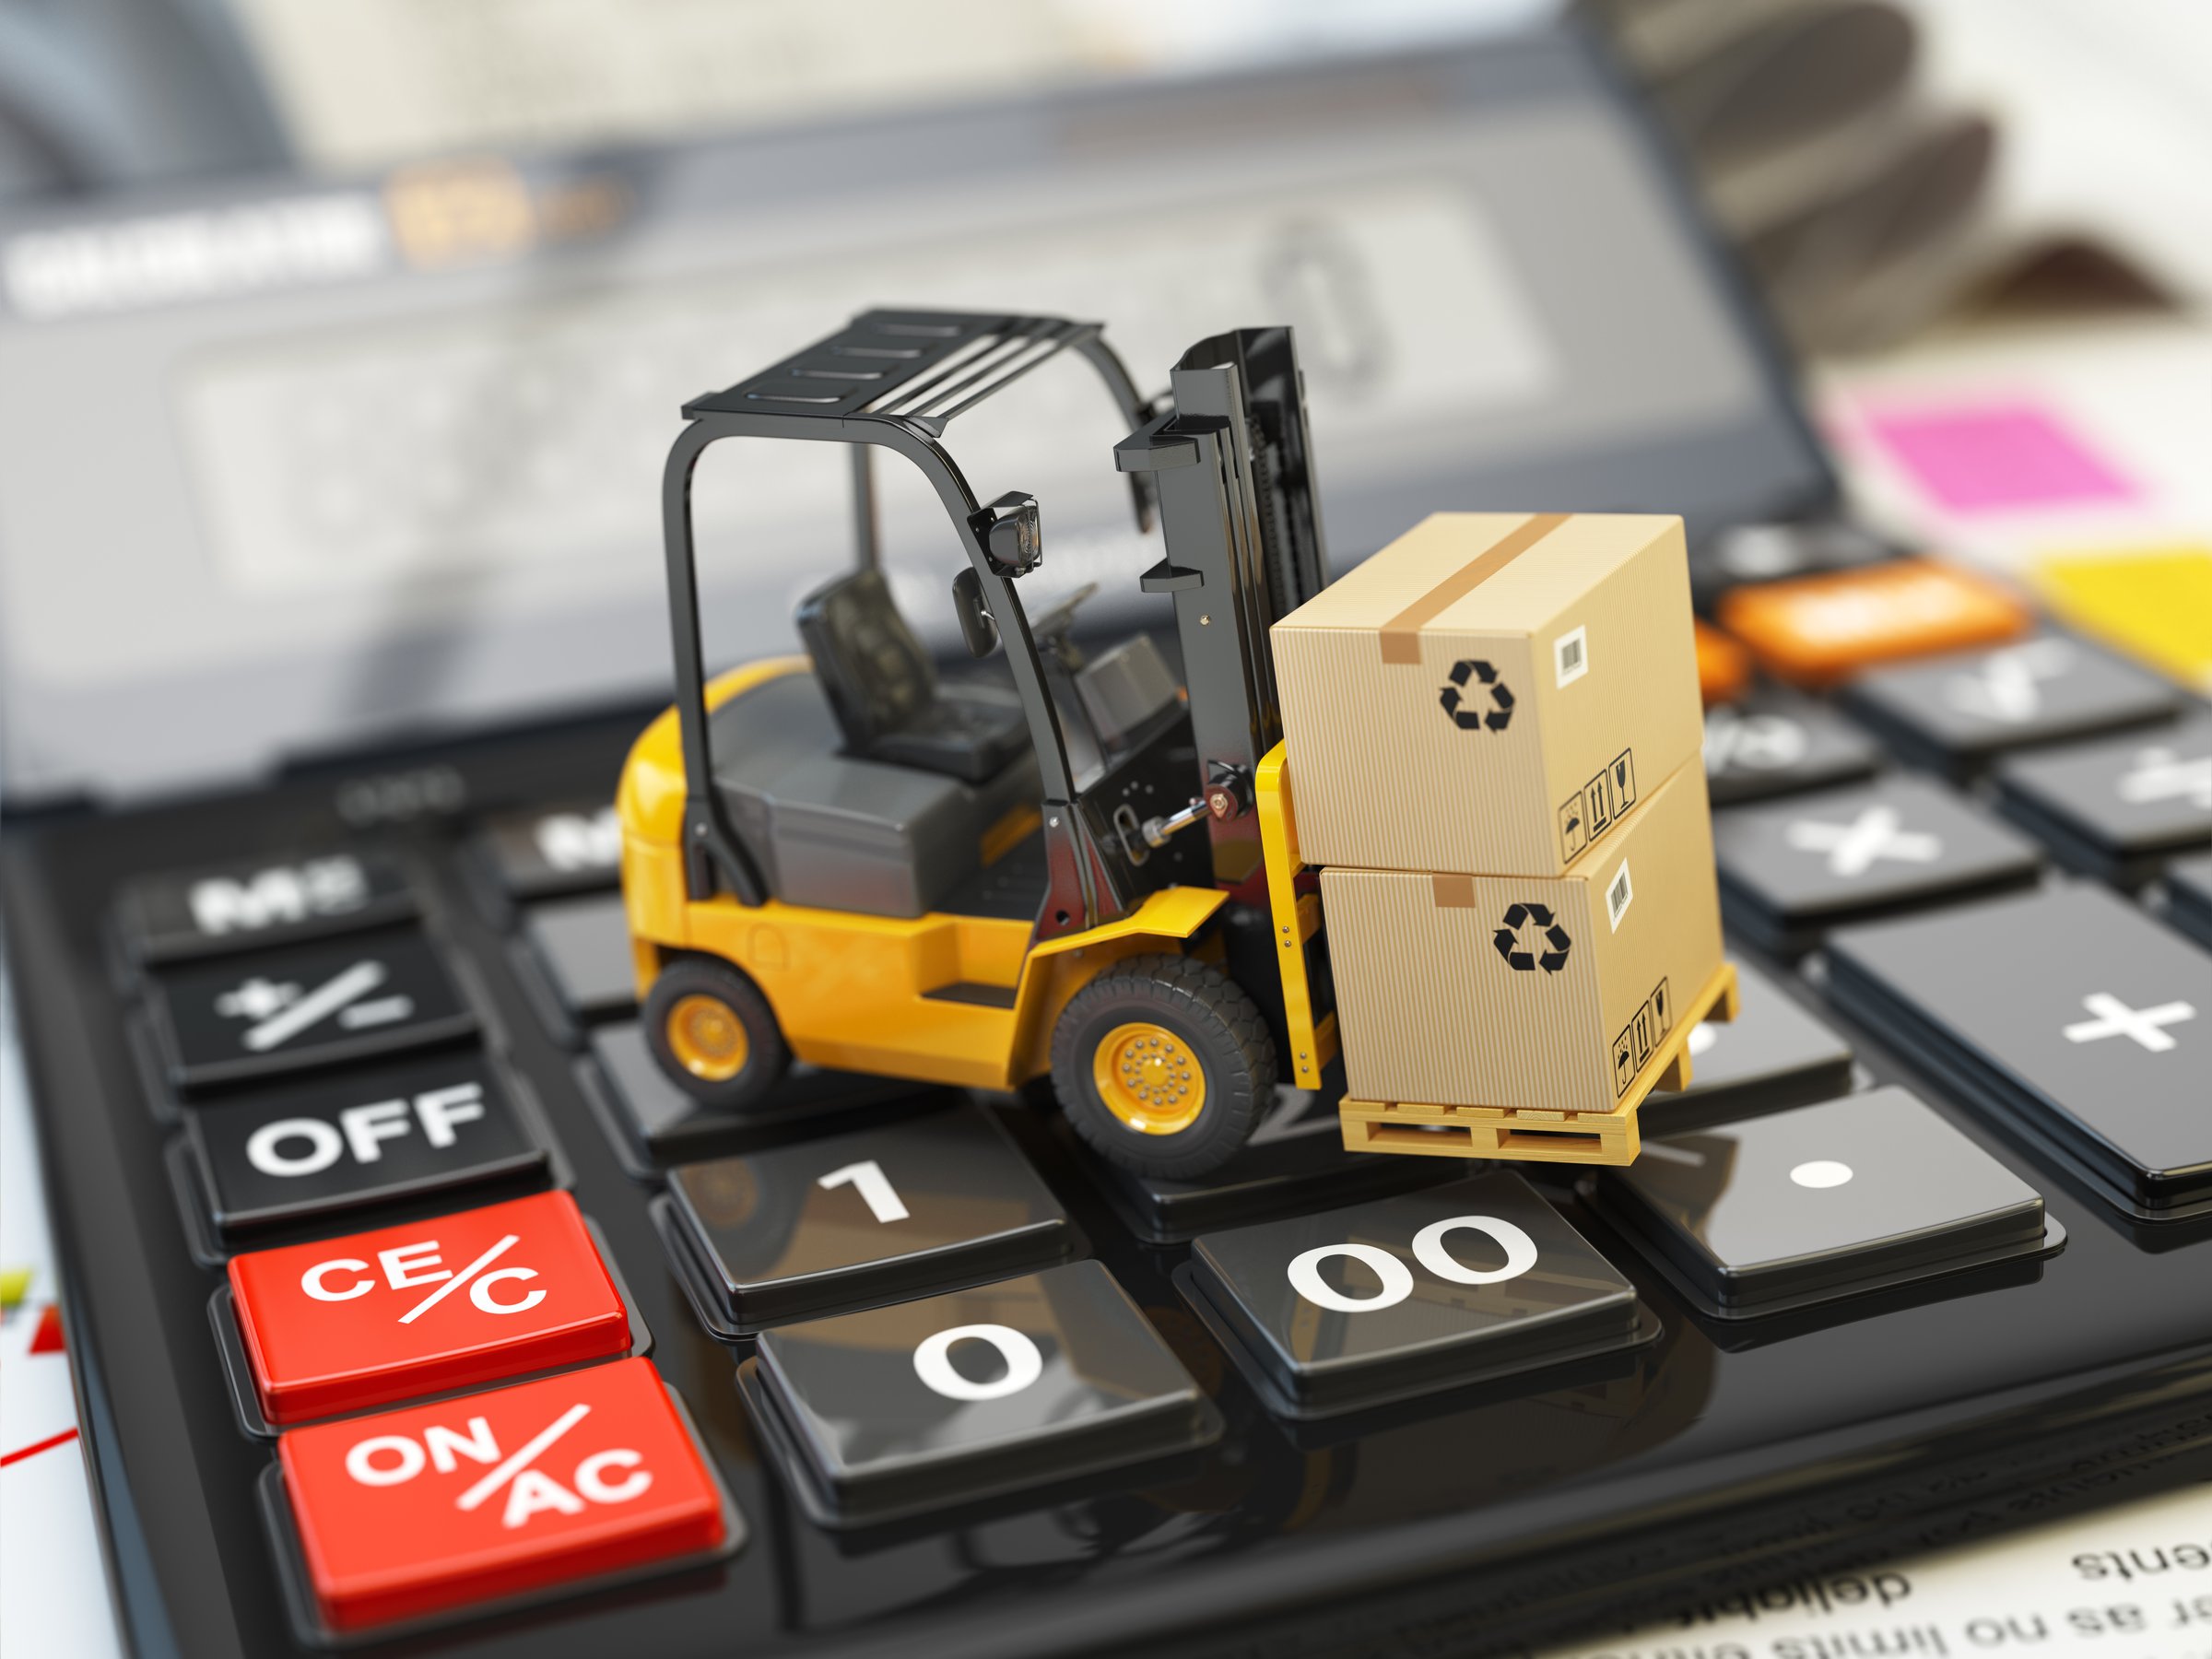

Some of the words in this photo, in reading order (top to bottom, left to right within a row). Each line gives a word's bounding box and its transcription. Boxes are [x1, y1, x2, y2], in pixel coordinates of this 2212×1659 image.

[532, 806, 622, 872] M
[246, 1082, 483, 1177] OFF
[817, 1159, 911, 1224] 1
[300, 1234, 547, 1324] CE/C
[1287, 1215, 1537, 1312] 00
[913, 1324, 1042, 1401] 0
[346, 1403, 653, 1529] ON/AC
[2071, 1543, 2212, 1583] ents
[1964, 1613, 2049, 1648] no
[2067, 1604, 2147, 1638] as
